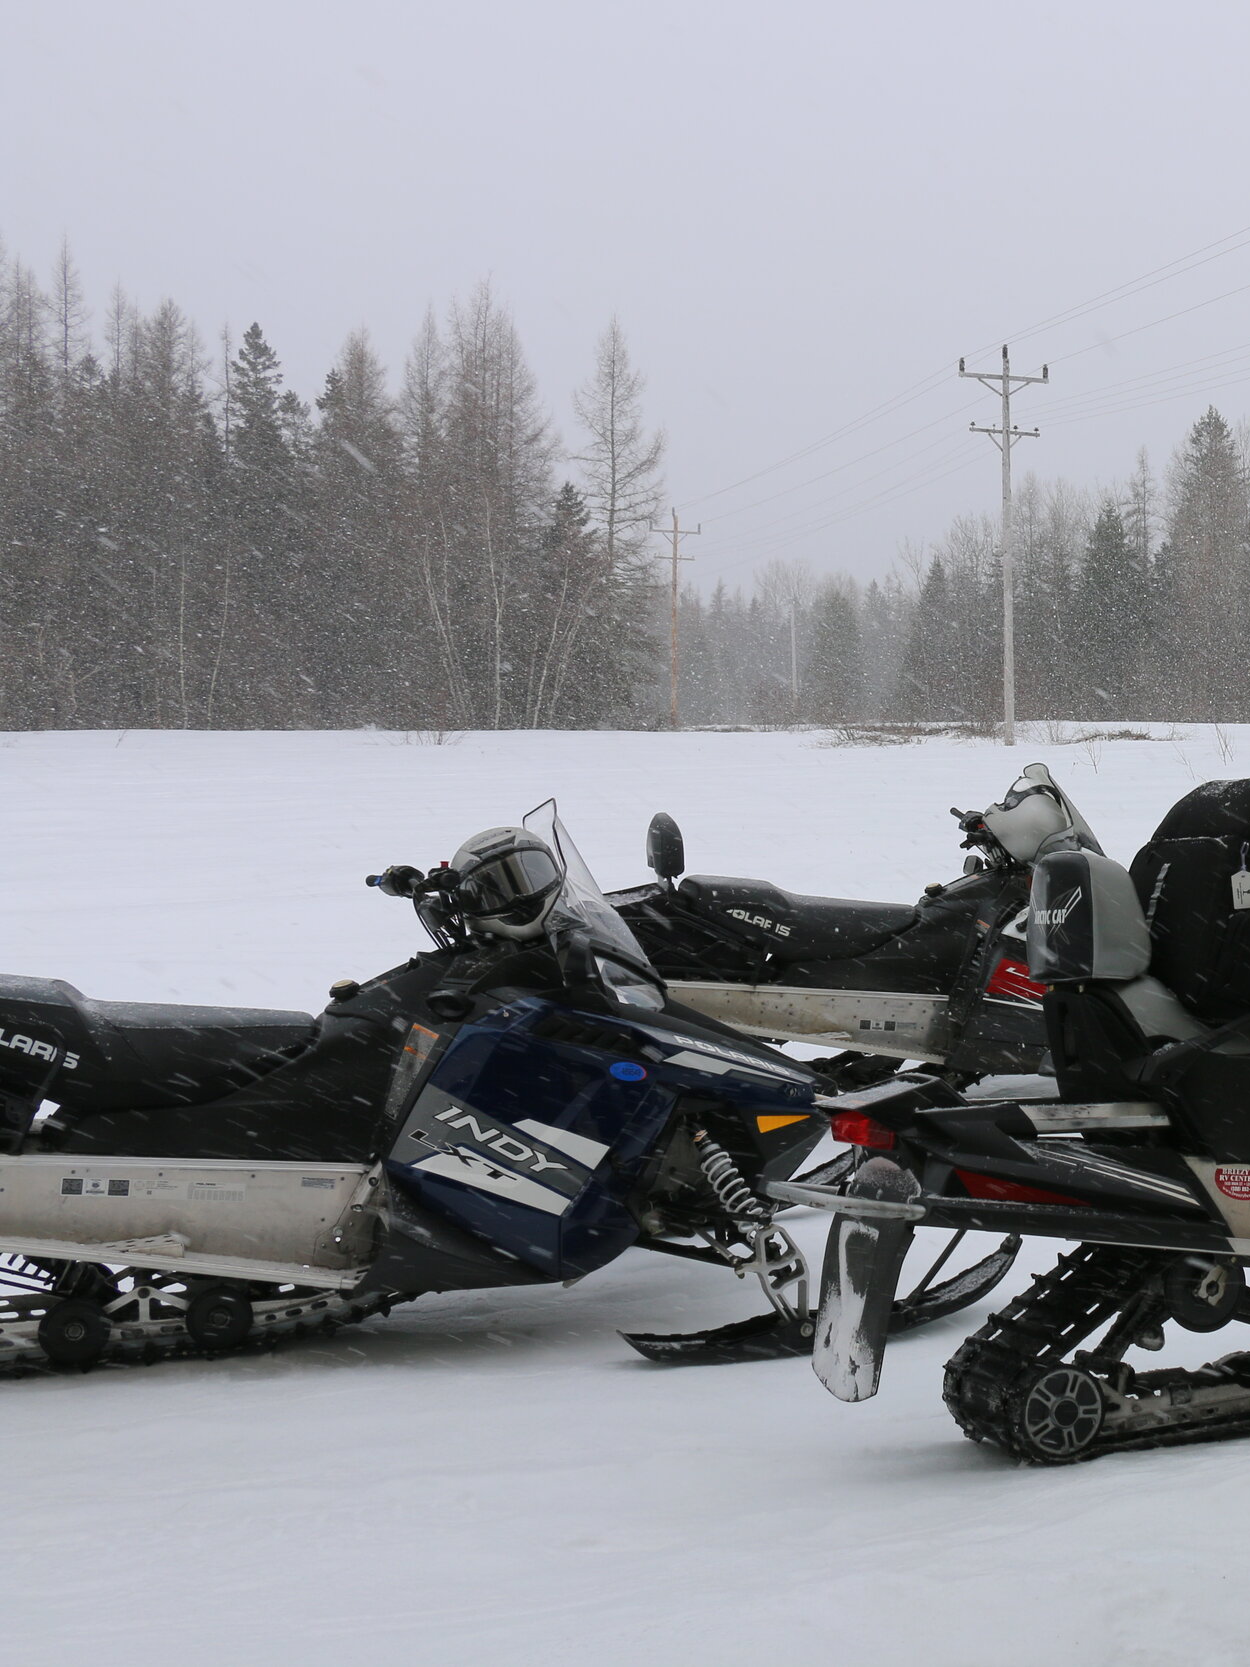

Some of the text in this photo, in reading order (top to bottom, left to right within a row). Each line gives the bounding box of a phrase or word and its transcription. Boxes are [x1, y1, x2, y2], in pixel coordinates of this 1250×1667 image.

[1052, 908, 1067, 924] CAT
[673, 1034, 791, 1076] POLARIS
[408, 1129, 518, 1182] LXT
[433, 1105, 569, 1173] INDY
[1222, 1168, 1250, 1176] BREEZY
